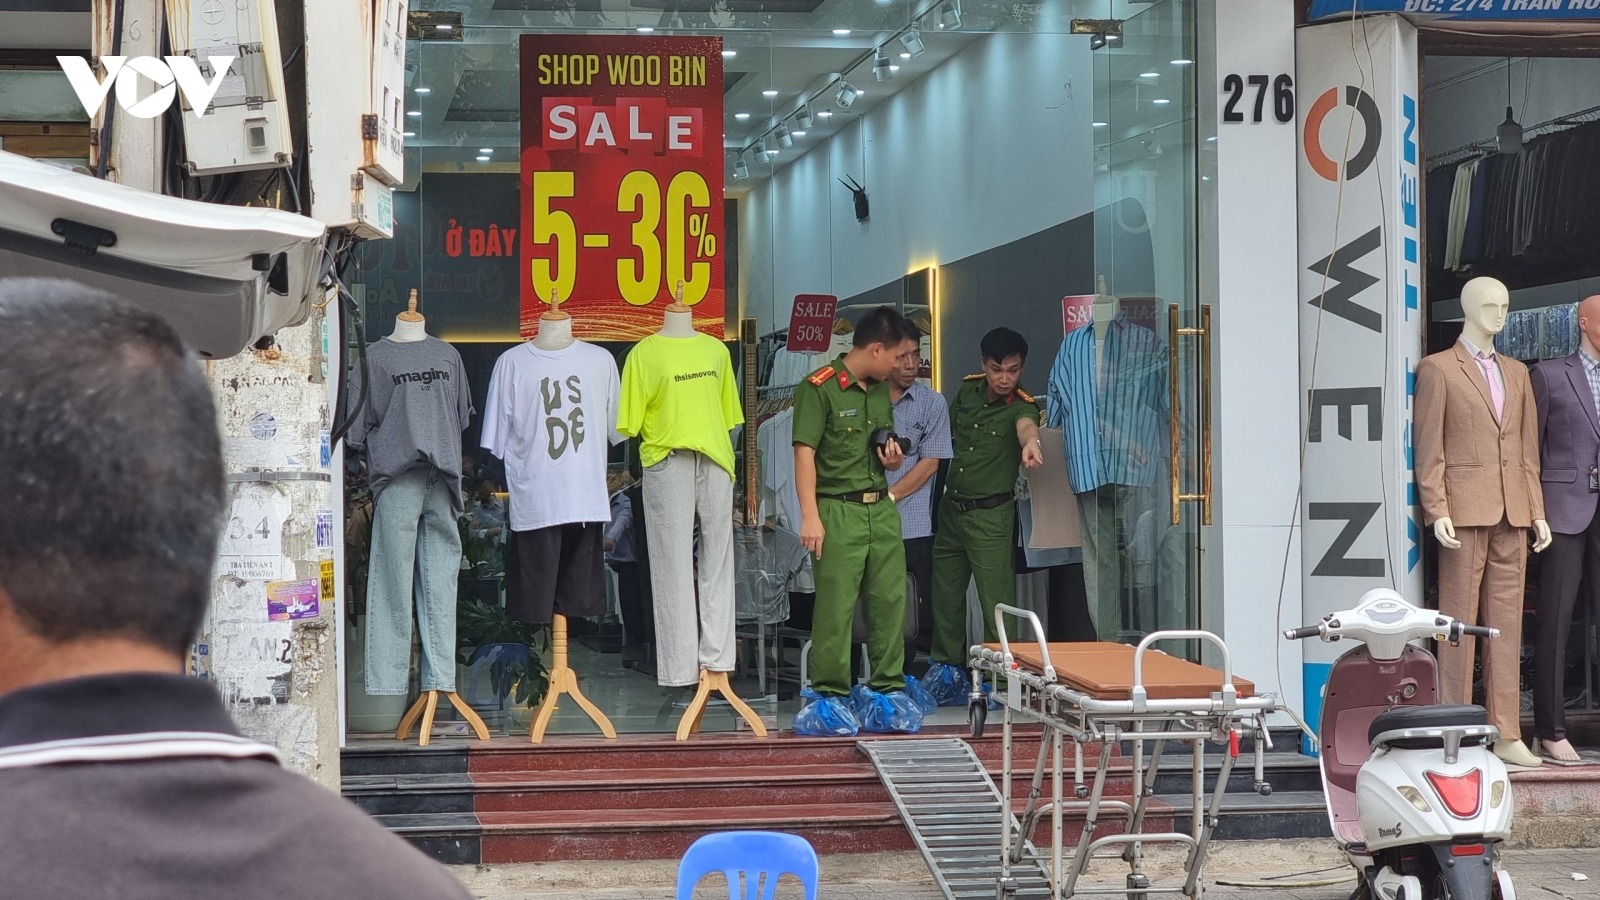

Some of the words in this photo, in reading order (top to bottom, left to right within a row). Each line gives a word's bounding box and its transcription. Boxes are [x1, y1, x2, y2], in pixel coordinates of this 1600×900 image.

[1449, 0, 1493, 11] 274
[538, 53, 600, 86] SHOP
[606, 54, 661, 87] WOO
[669, 54, 707, 87] BIN
[1223, 74, 1294, 123] 276
[549, 104, 693, 150] SALE
[1399, 93, 1418, 323] TIẾN
[446, 218, 463, 257] Ở
[469, 224, 517, 257] ĐÂY
[795, 302, 833, 318] SALE
[1067, 305, 1094, 323] SA
[796, 325, 824, 342] 50%
[1303, 85, 1386, 577] OWEN
[391, 368, 450, 386] imagine
